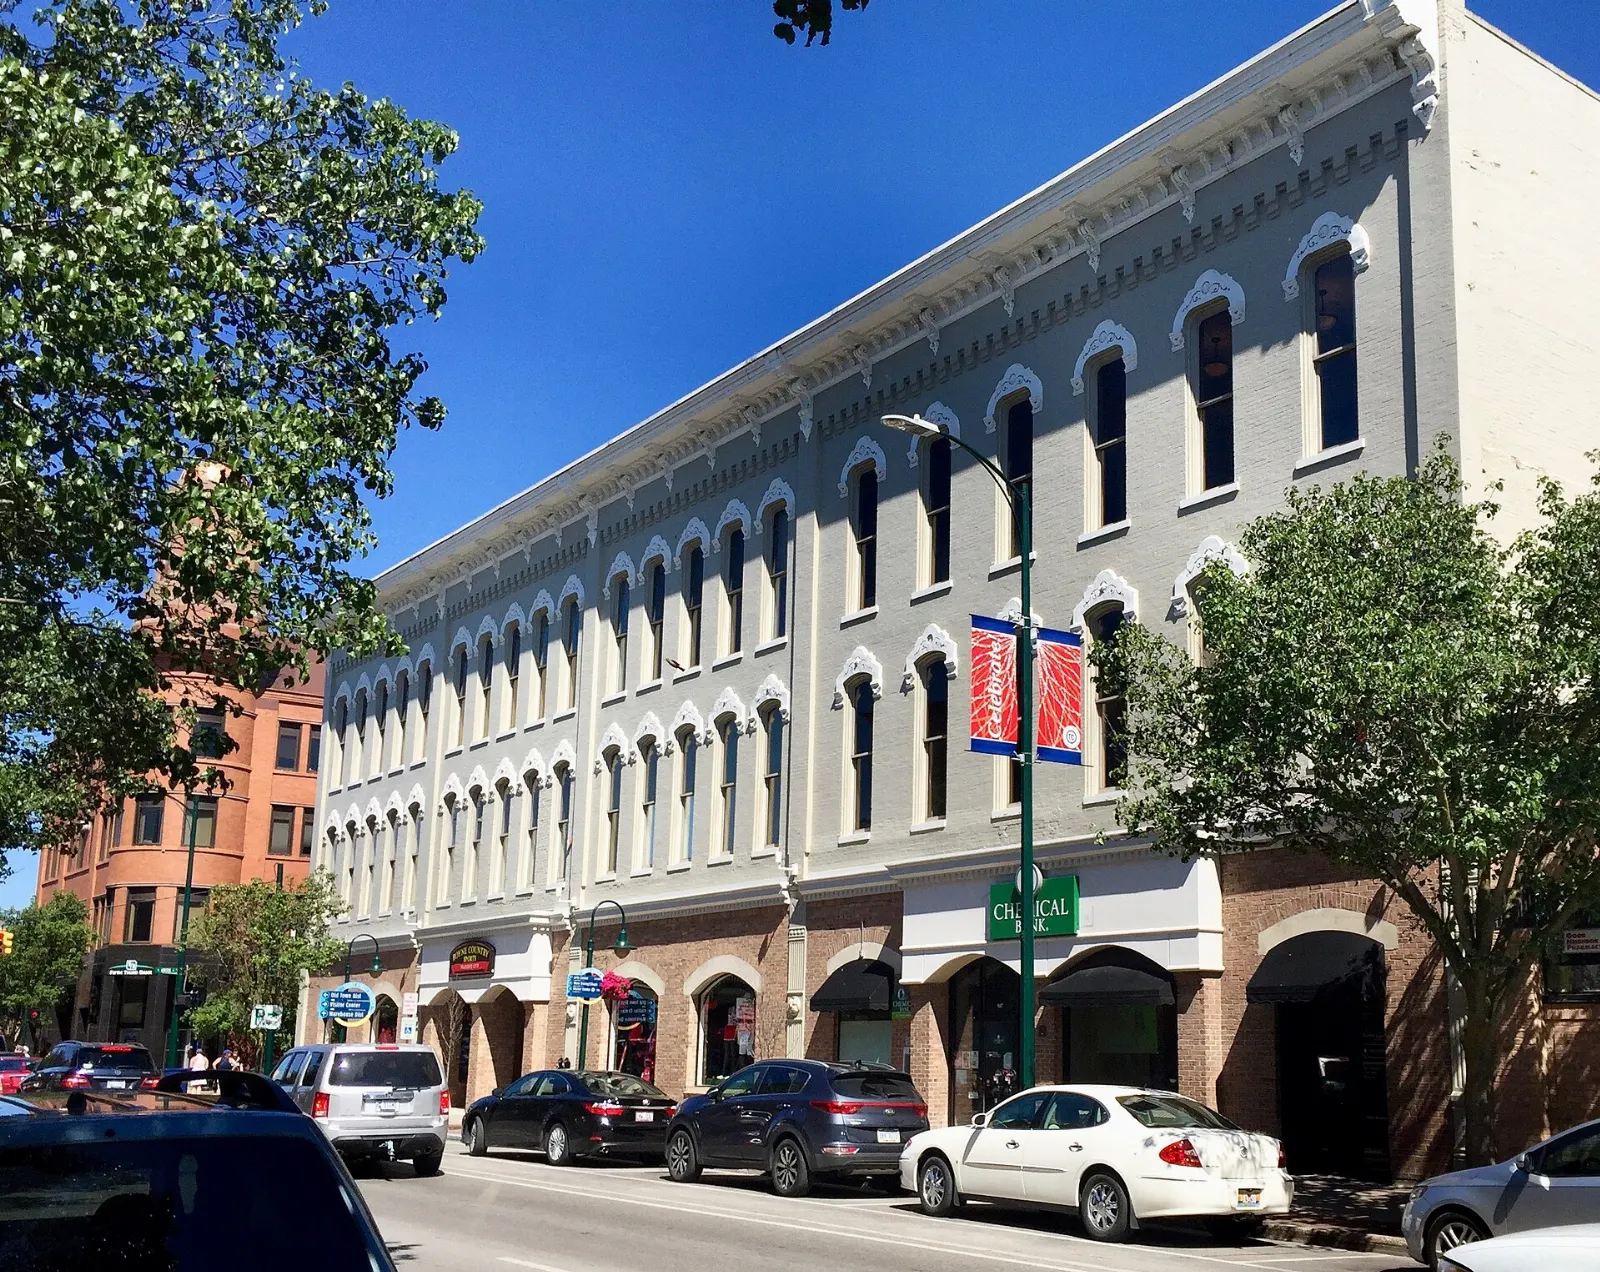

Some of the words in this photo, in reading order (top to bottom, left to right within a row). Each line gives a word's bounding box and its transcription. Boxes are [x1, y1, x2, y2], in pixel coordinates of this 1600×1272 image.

[987, 634, 1002, 739] Celebrate!
[993, 898, 1069, 920] CHEICAL
[468, 946, 490, 958] COUNTRY
[254, 1008, 266, 1026] P
